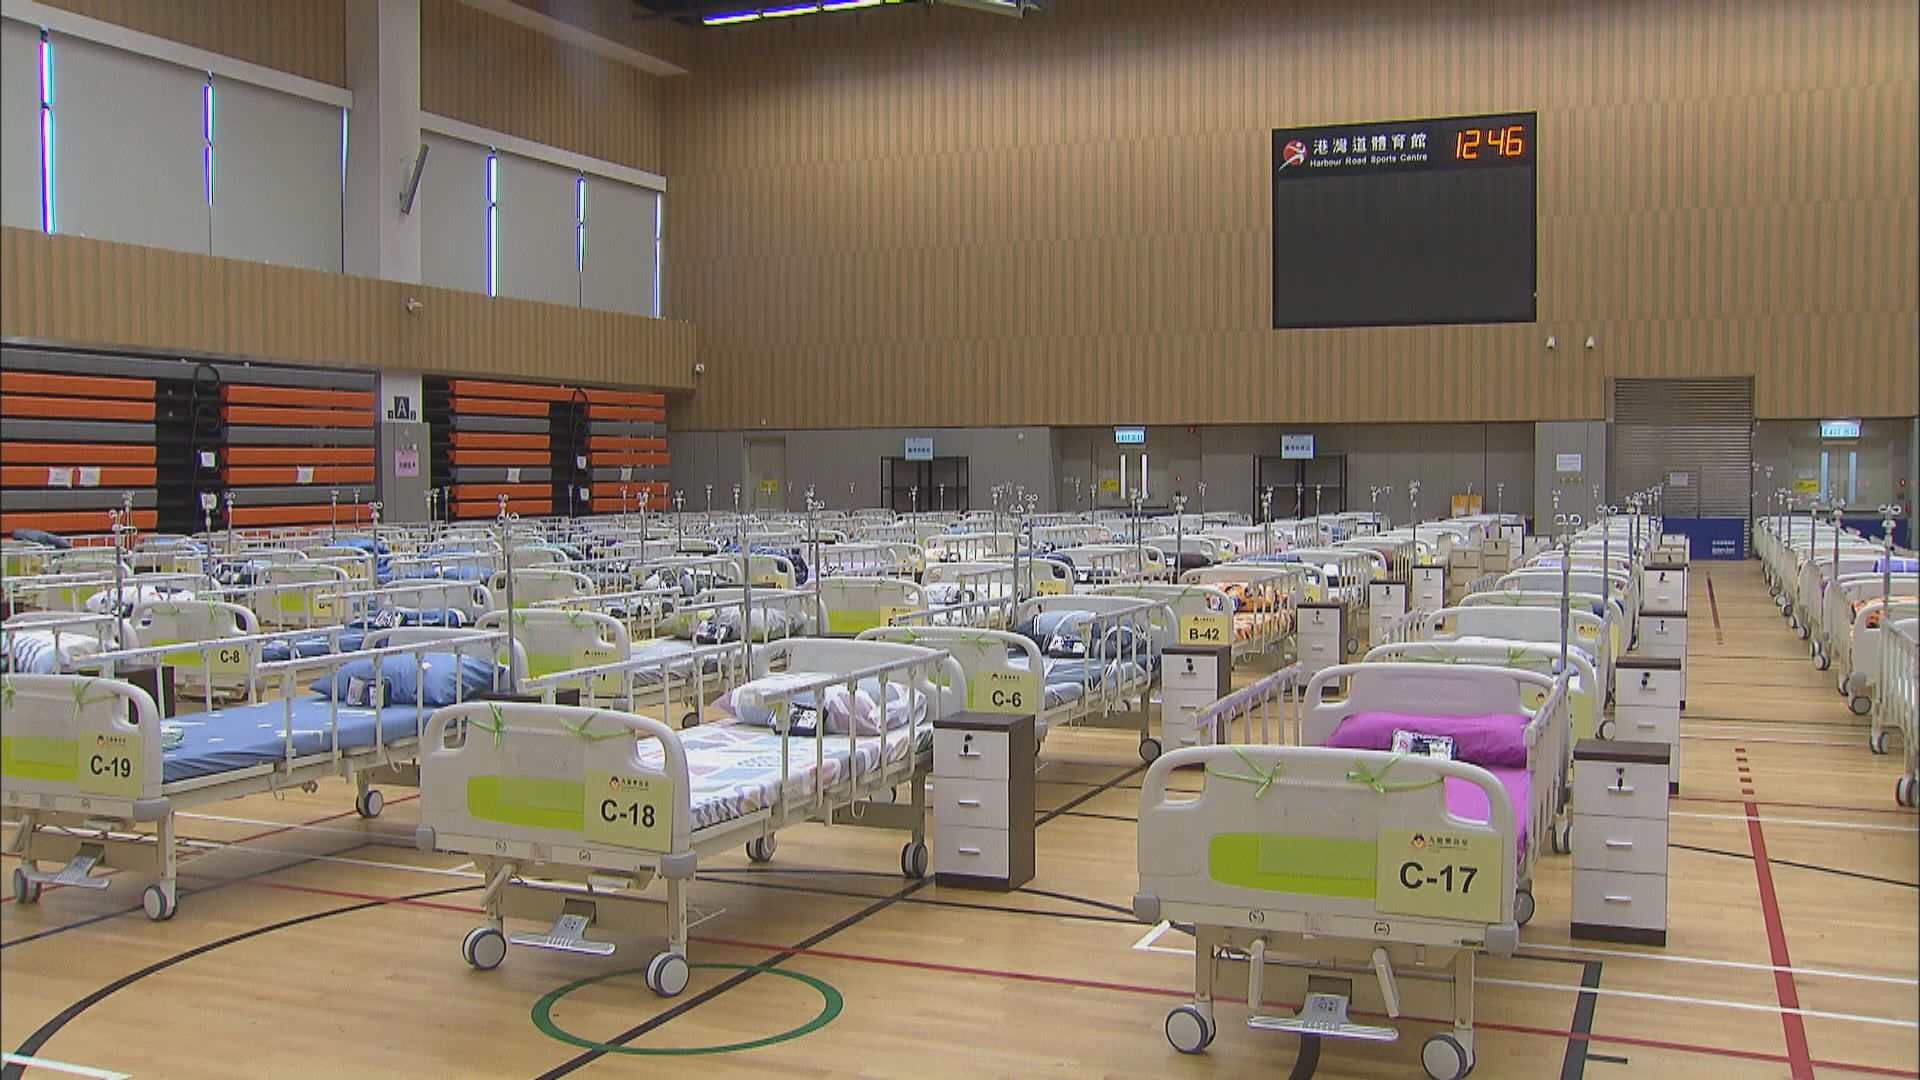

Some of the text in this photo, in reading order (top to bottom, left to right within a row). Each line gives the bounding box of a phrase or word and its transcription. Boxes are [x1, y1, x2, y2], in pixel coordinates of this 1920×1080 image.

[1313, 131, 1428, 156] 港灣道體育館
[1310, 153, 1428, 168] Harbour Road Sports Centre
[396, 399, 408, 417] A
[1189, 628, 1220, 641] B-42
[220, 650, 240, 664] C-8
[992, 690, 1022, 707] C-6
[90, 754, 131, 778] C-19
[601, 799, 655, 828] C-18
[1400, 861, 1478, 894] C-17
